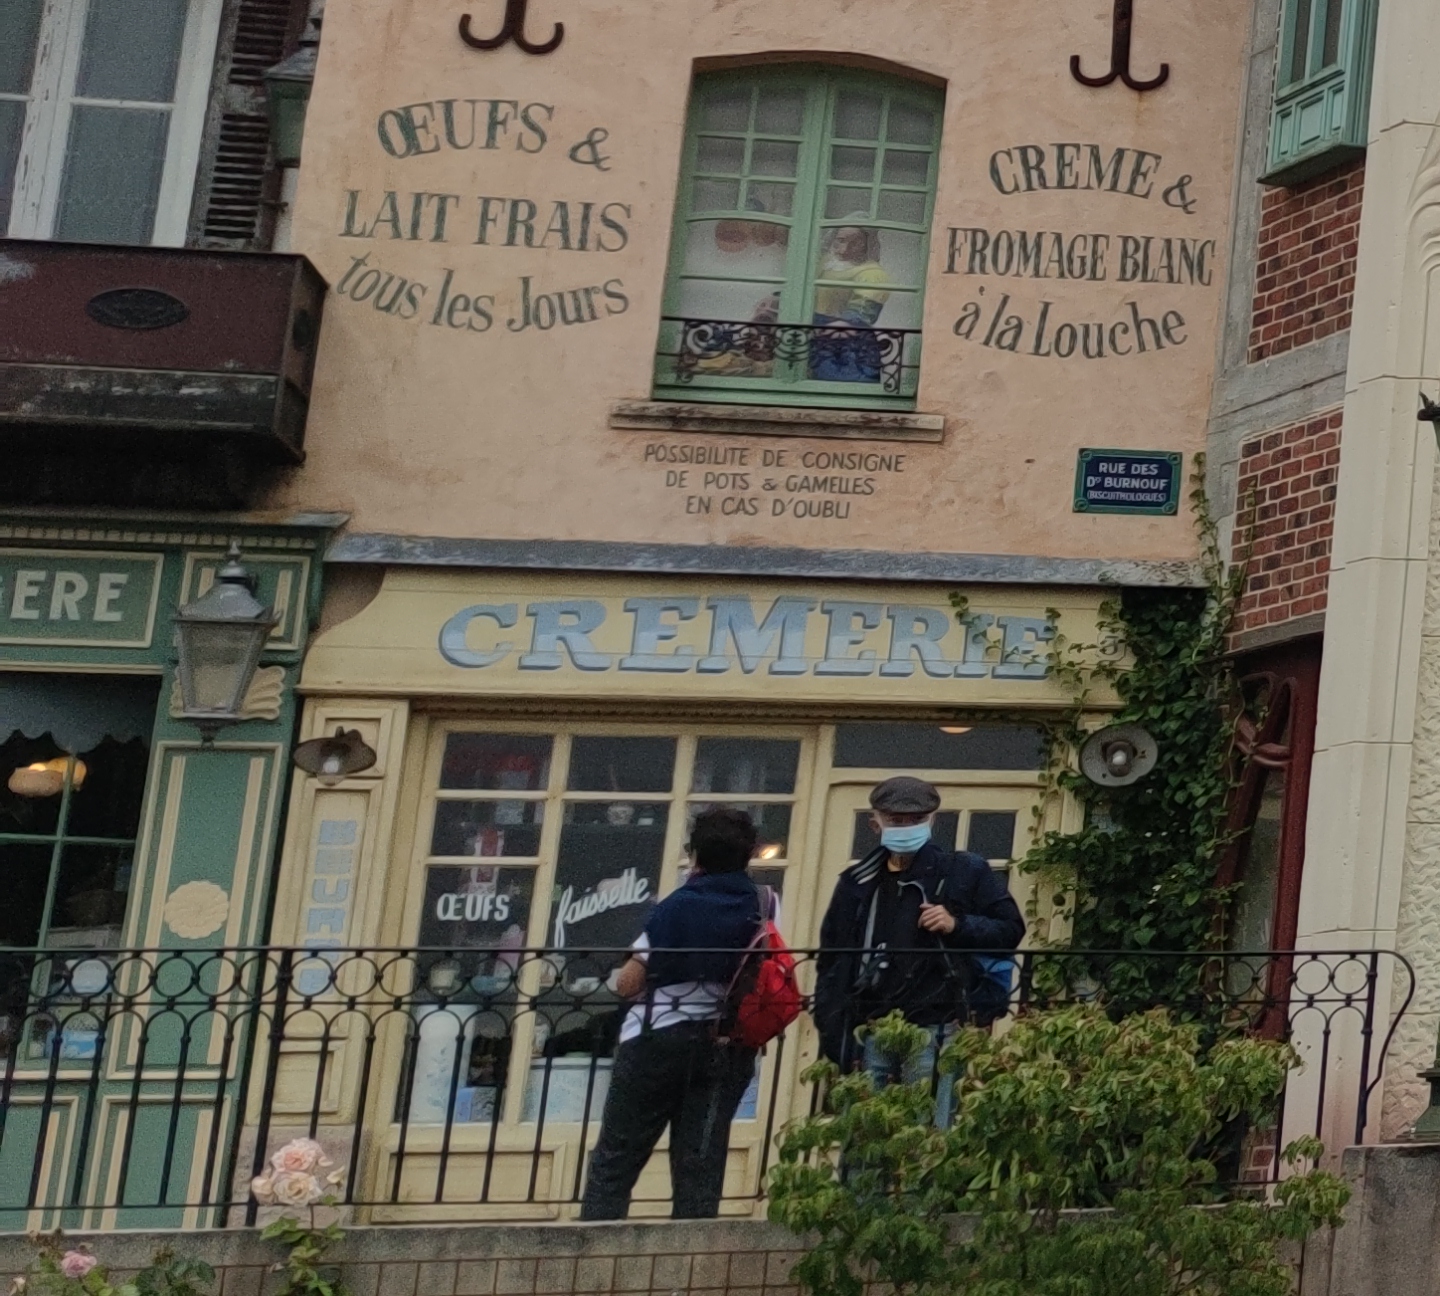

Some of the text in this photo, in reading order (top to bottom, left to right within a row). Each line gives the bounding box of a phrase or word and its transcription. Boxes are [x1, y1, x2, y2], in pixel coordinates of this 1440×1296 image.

[569, 127, 612, 171] &
[989, 143, 1197, 214] CREME &
[338, 190, 631, 252] LAIT FRAIS
[942, 226, 1216, 286] FROMAGE BLANC
[336, 251, 629, 332] tous les Jours
[980, 293, 1024, 354] la
[1027, 301, 1188, 359] Louche
[666, 470, 876, 495] DE POTS & GAMELLES
[762, 449, 787, 467] DE
[802, 451, 906, 472] CONSIGNE
[1099, 462, 1159, 475] RUE DES
[1104, 477, 1170, 490] BURNOUF
[686, 495, 850, 519] EN CAS D'OUBLI
[0, 569, 129, 622] ERE
[438, 593, 1053, 680] CREMERIE
